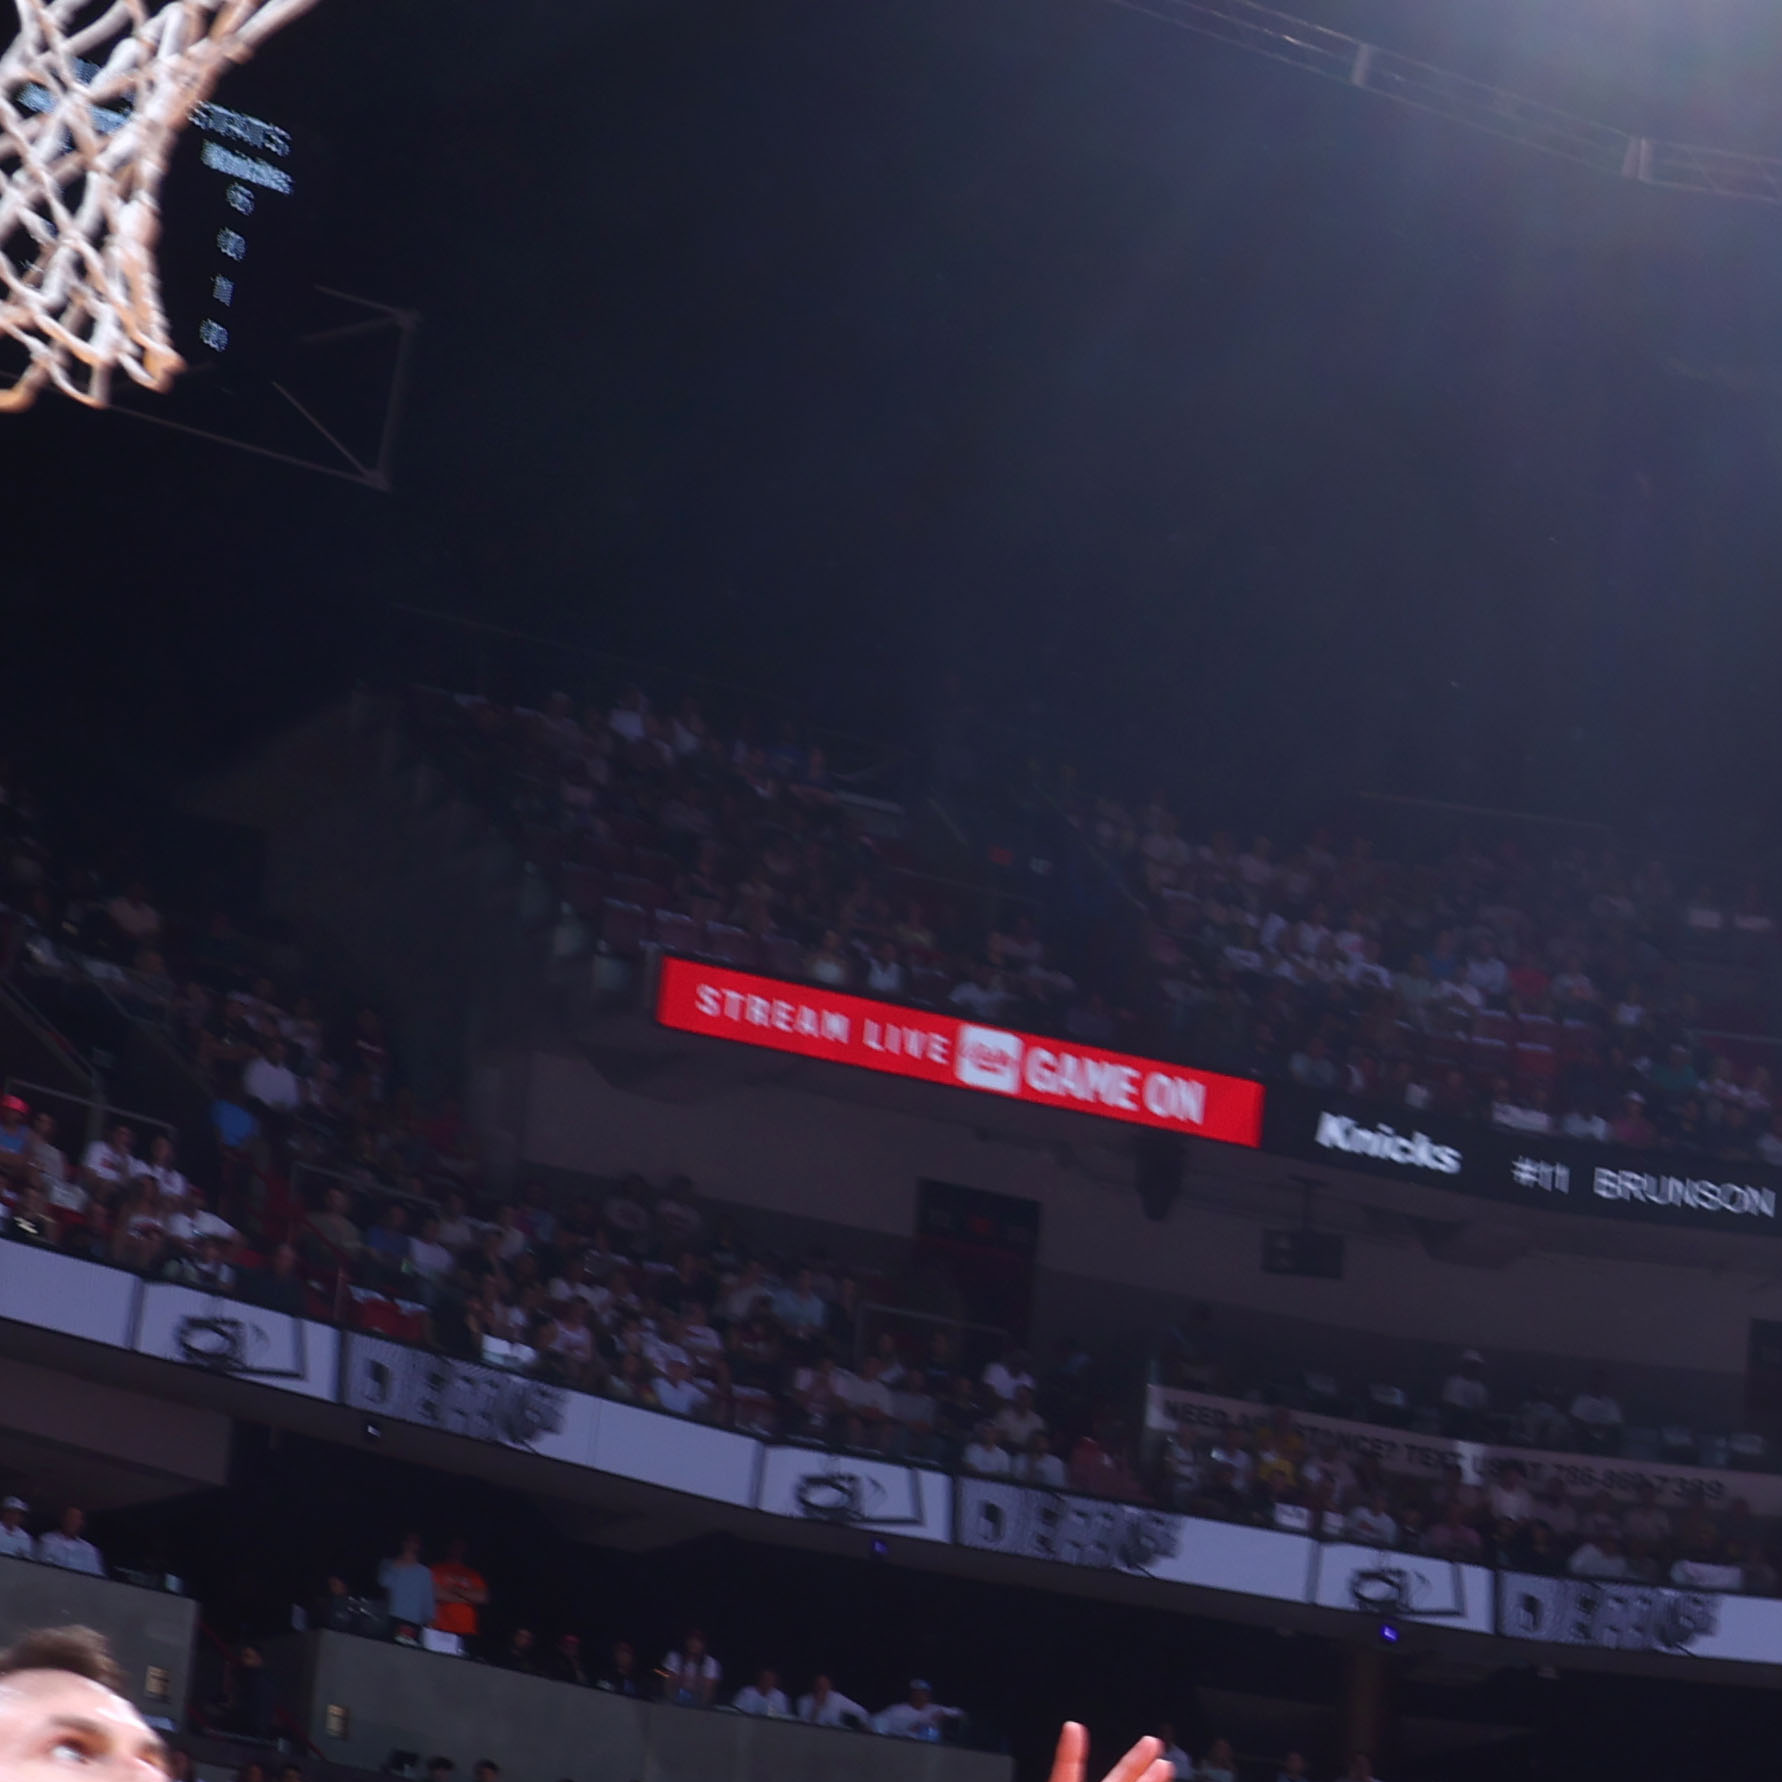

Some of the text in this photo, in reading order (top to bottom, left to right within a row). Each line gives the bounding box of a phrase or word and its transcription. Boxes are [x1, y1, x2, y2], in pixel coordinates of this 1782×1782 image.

[695, 982, 850, 1046] STREAM
[862, 1018, 951, 1066] LIVE
[1025, 1045, 1140, 1113] GAME
[1144, 1072, 1206, 1125] ON
[1314, 1110, 1462, 1175] Knicks
[1511, 1154, 1777, 1218] #11 BRUNSON
